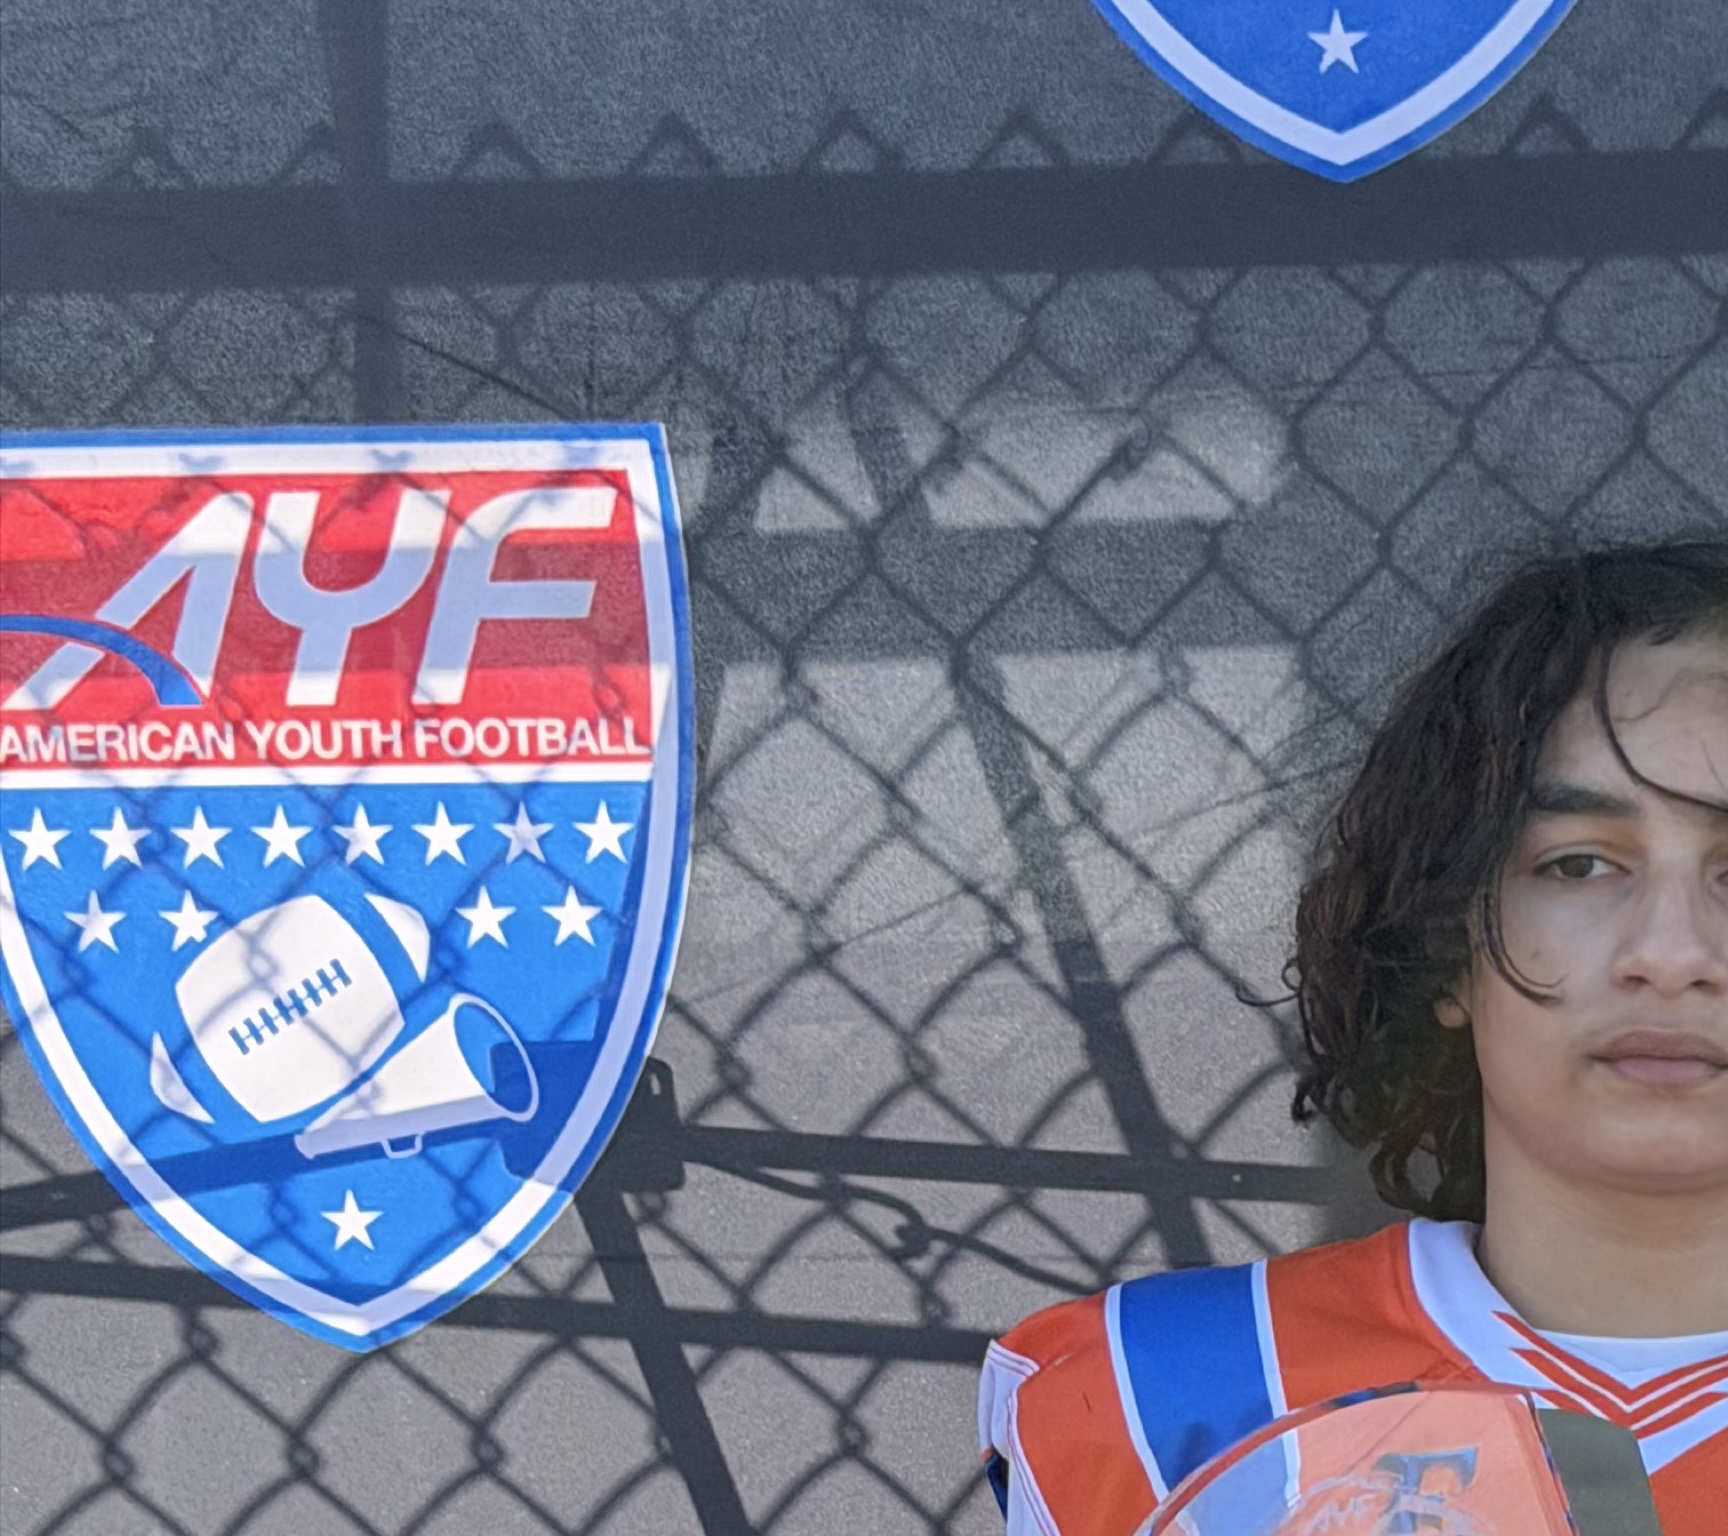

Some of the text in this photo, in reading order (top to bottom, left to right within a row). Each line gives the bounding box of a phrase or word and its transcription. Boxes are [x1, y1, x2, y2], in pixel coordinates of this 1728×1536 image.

[0, 486, 618, 711] AYF
[0, 715, 654, 765] AMERICAN YOUTH FOOTBALL
